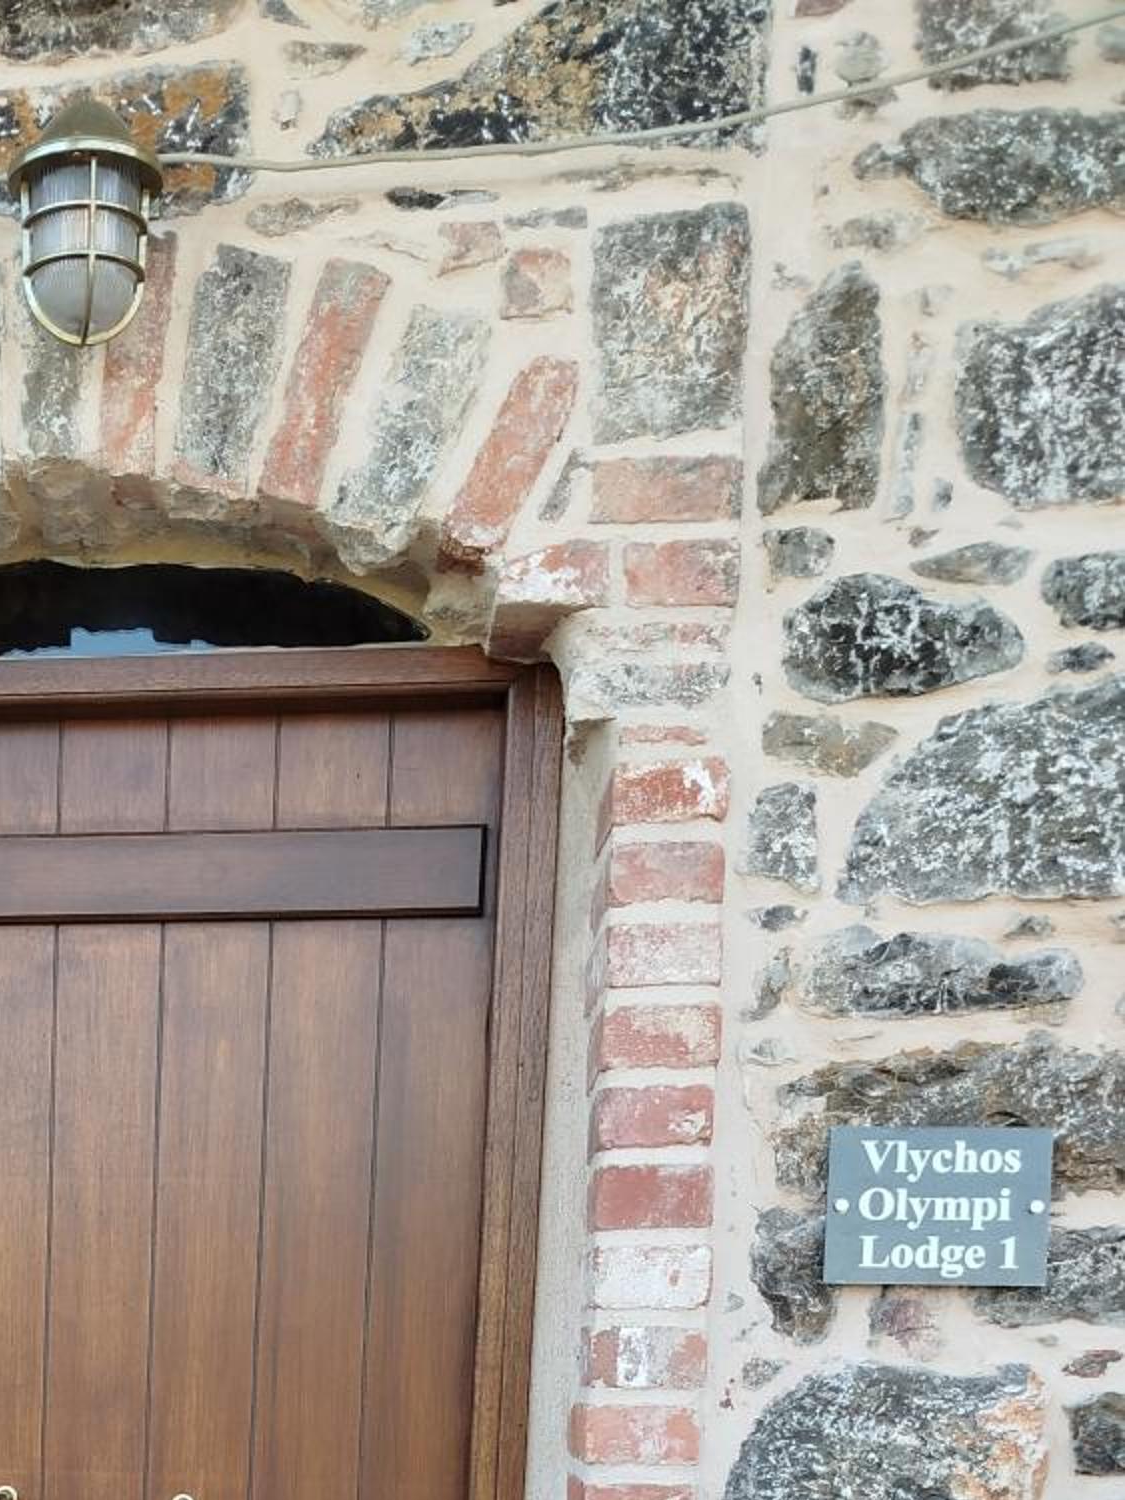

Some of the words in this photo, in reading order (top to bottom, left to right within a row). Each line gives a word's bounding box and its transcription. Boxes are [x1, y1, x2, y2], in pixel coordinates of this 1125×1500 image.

[861, 1139, 1022, 1183] Vlychos
[858, 1187, 1011, 1231] Olympi
[858, 1235, 986, 1278] Lodge
[998, 1236, 1020, 1270] 1
